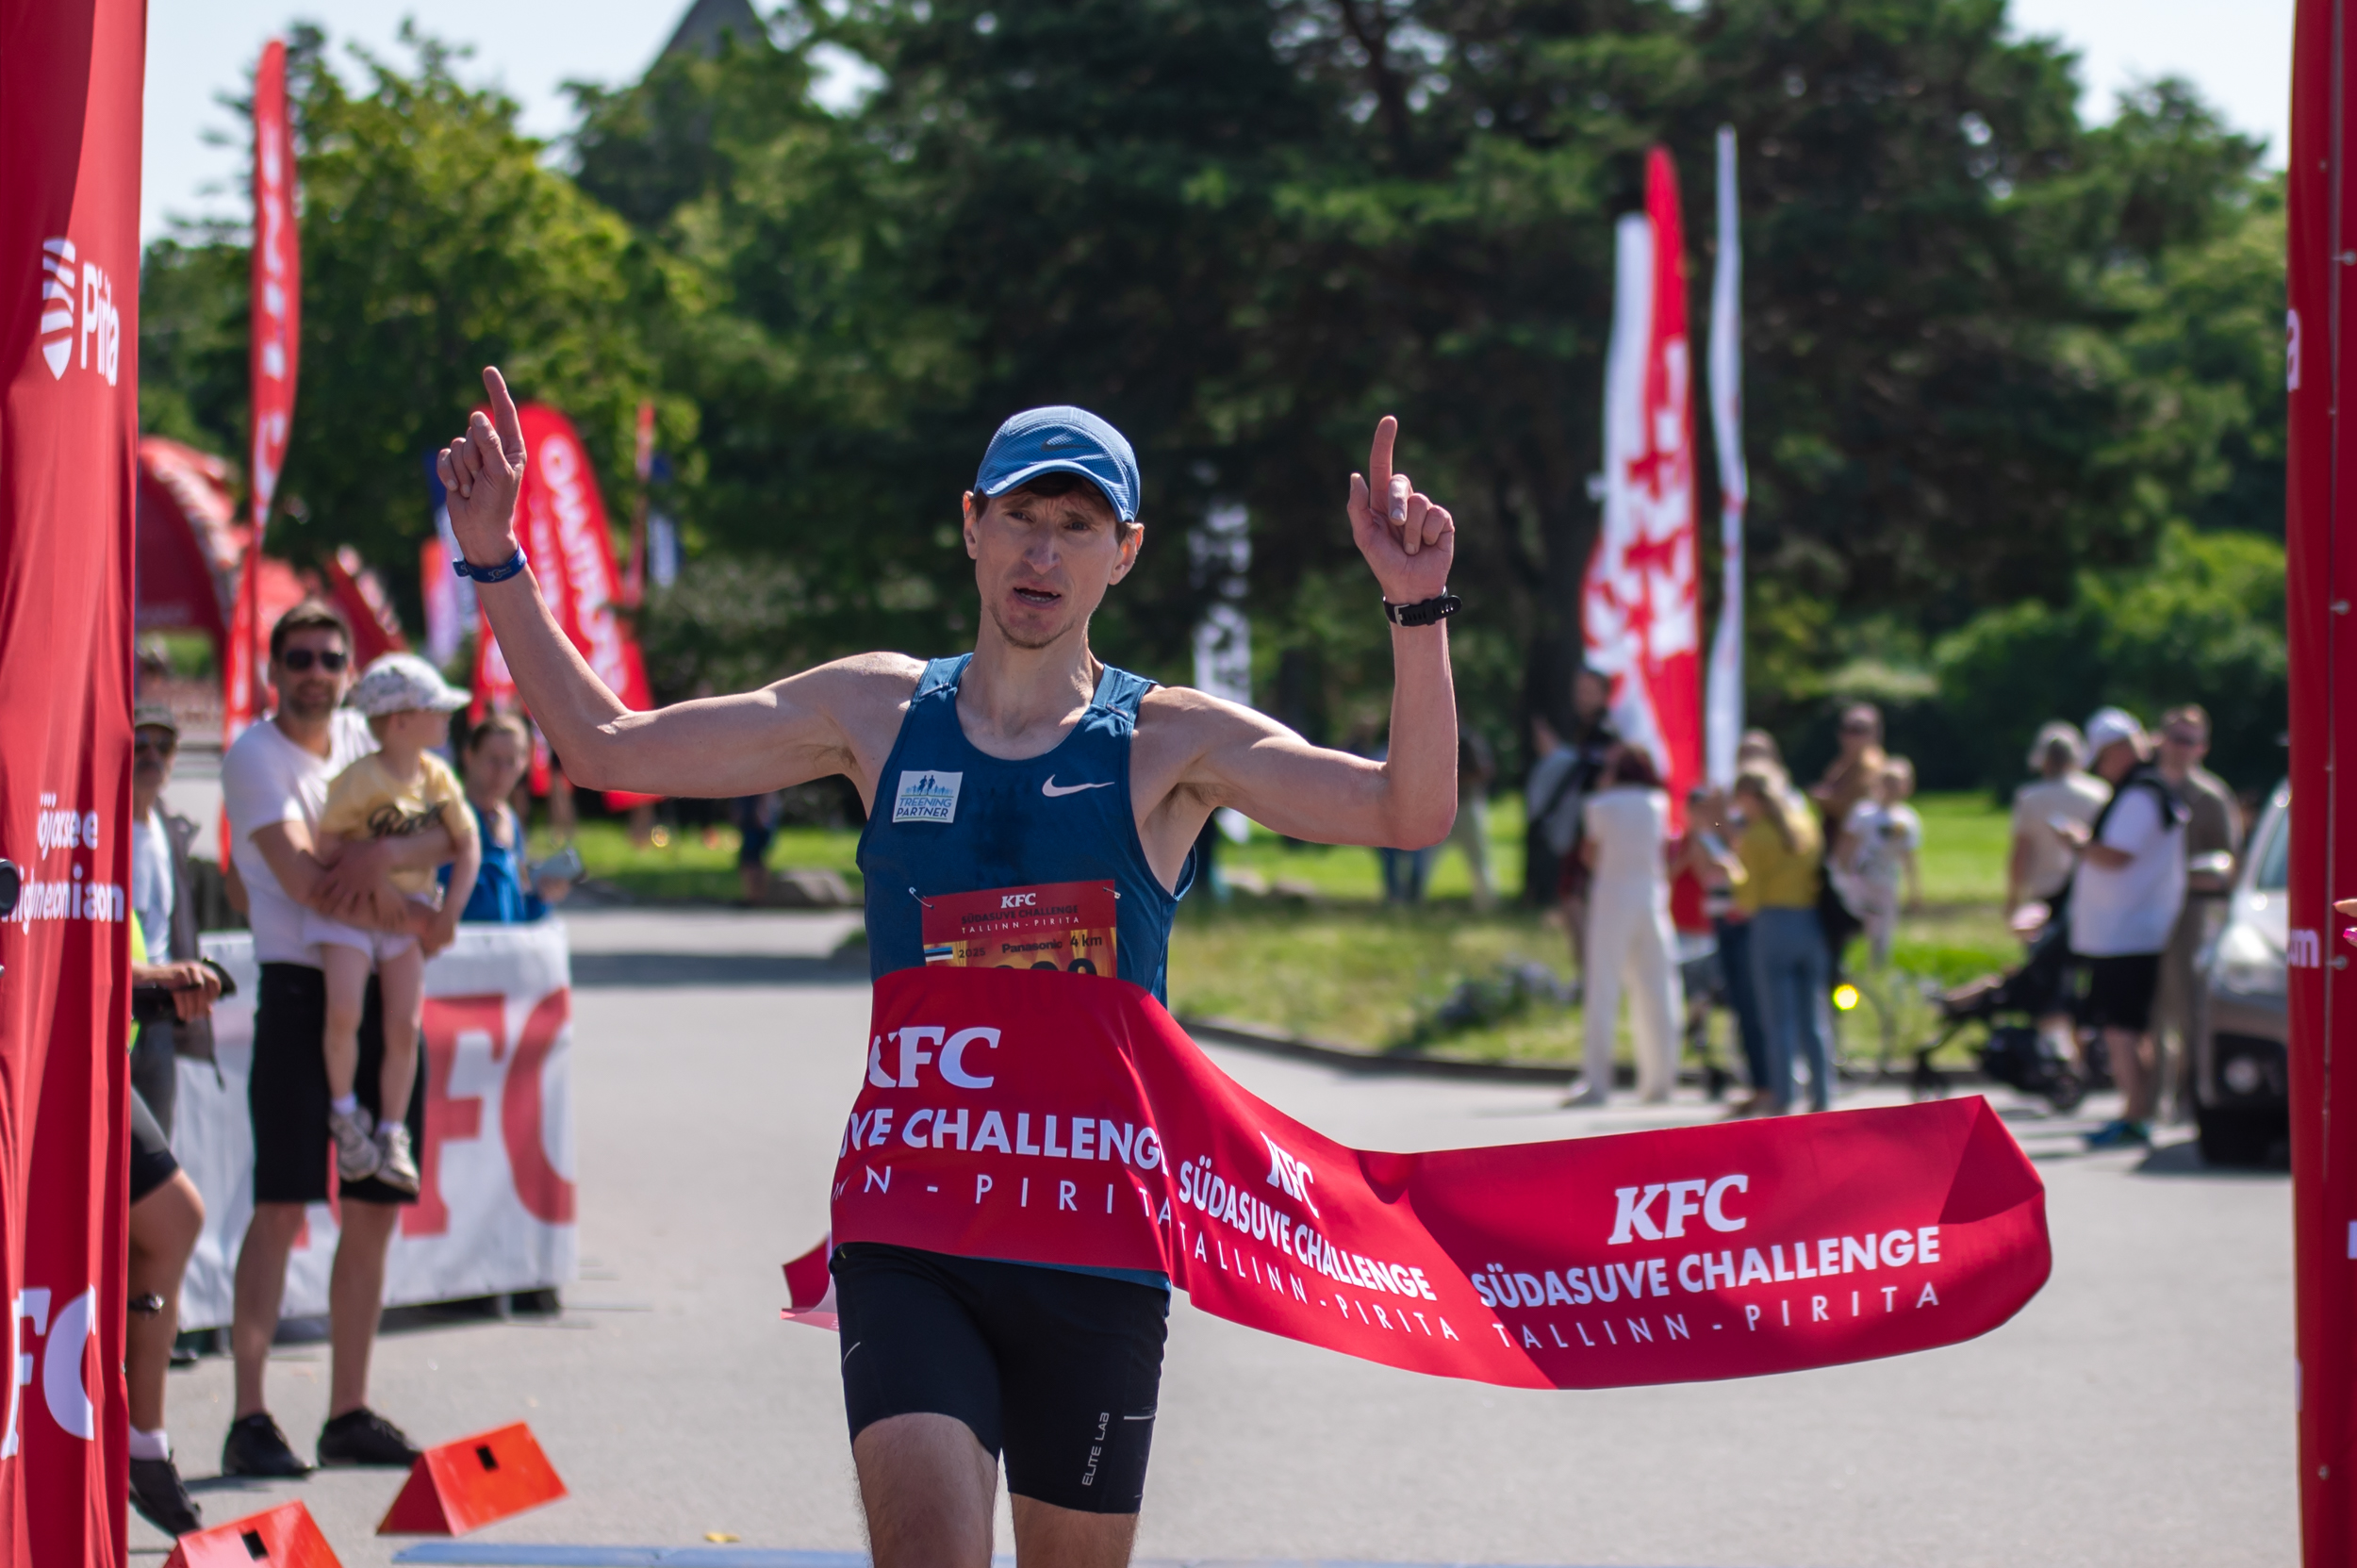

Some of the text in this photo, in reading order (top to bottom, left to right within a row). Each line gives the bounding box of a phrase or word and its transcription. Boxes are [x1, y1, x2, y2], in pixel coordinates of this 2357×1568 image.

[896, 806, 948, 817] PARTNER
[899, 797, 952, 807] TREENING
[961, 904, 1079, 925] SÜDASUVE CHALLENGE
[961, 920, 1020, 934] TALLINN
[1033, 916, 1080, 927] PIRITA
[1000, 892, 1037, 909] KFC
[958, 933, 1102, 959] 2025 Panasonic 4 km
[901, 1108, 1169, 1178] CHALLENG
[975, 1173, 1172, 1230] PIRITA
[1178, 1154, 1438, 1301] SÜDASUVE CHALLENGE
[1607, 1174, 1749, 1246] KFC
[1178, 1220, 1308, 1305] TALLINN
[1334, 1293, 1459, 1342] PIRITA
[1471, 1225, 1940, 1308] SÜDASUVE CHALLENGE
[1492, 1312, 1691, 1349] TALLINN
[1744, 1280, 1939, 1331] PIRITA
[1081, 1411, 1110, 1487] ELITE LAB
